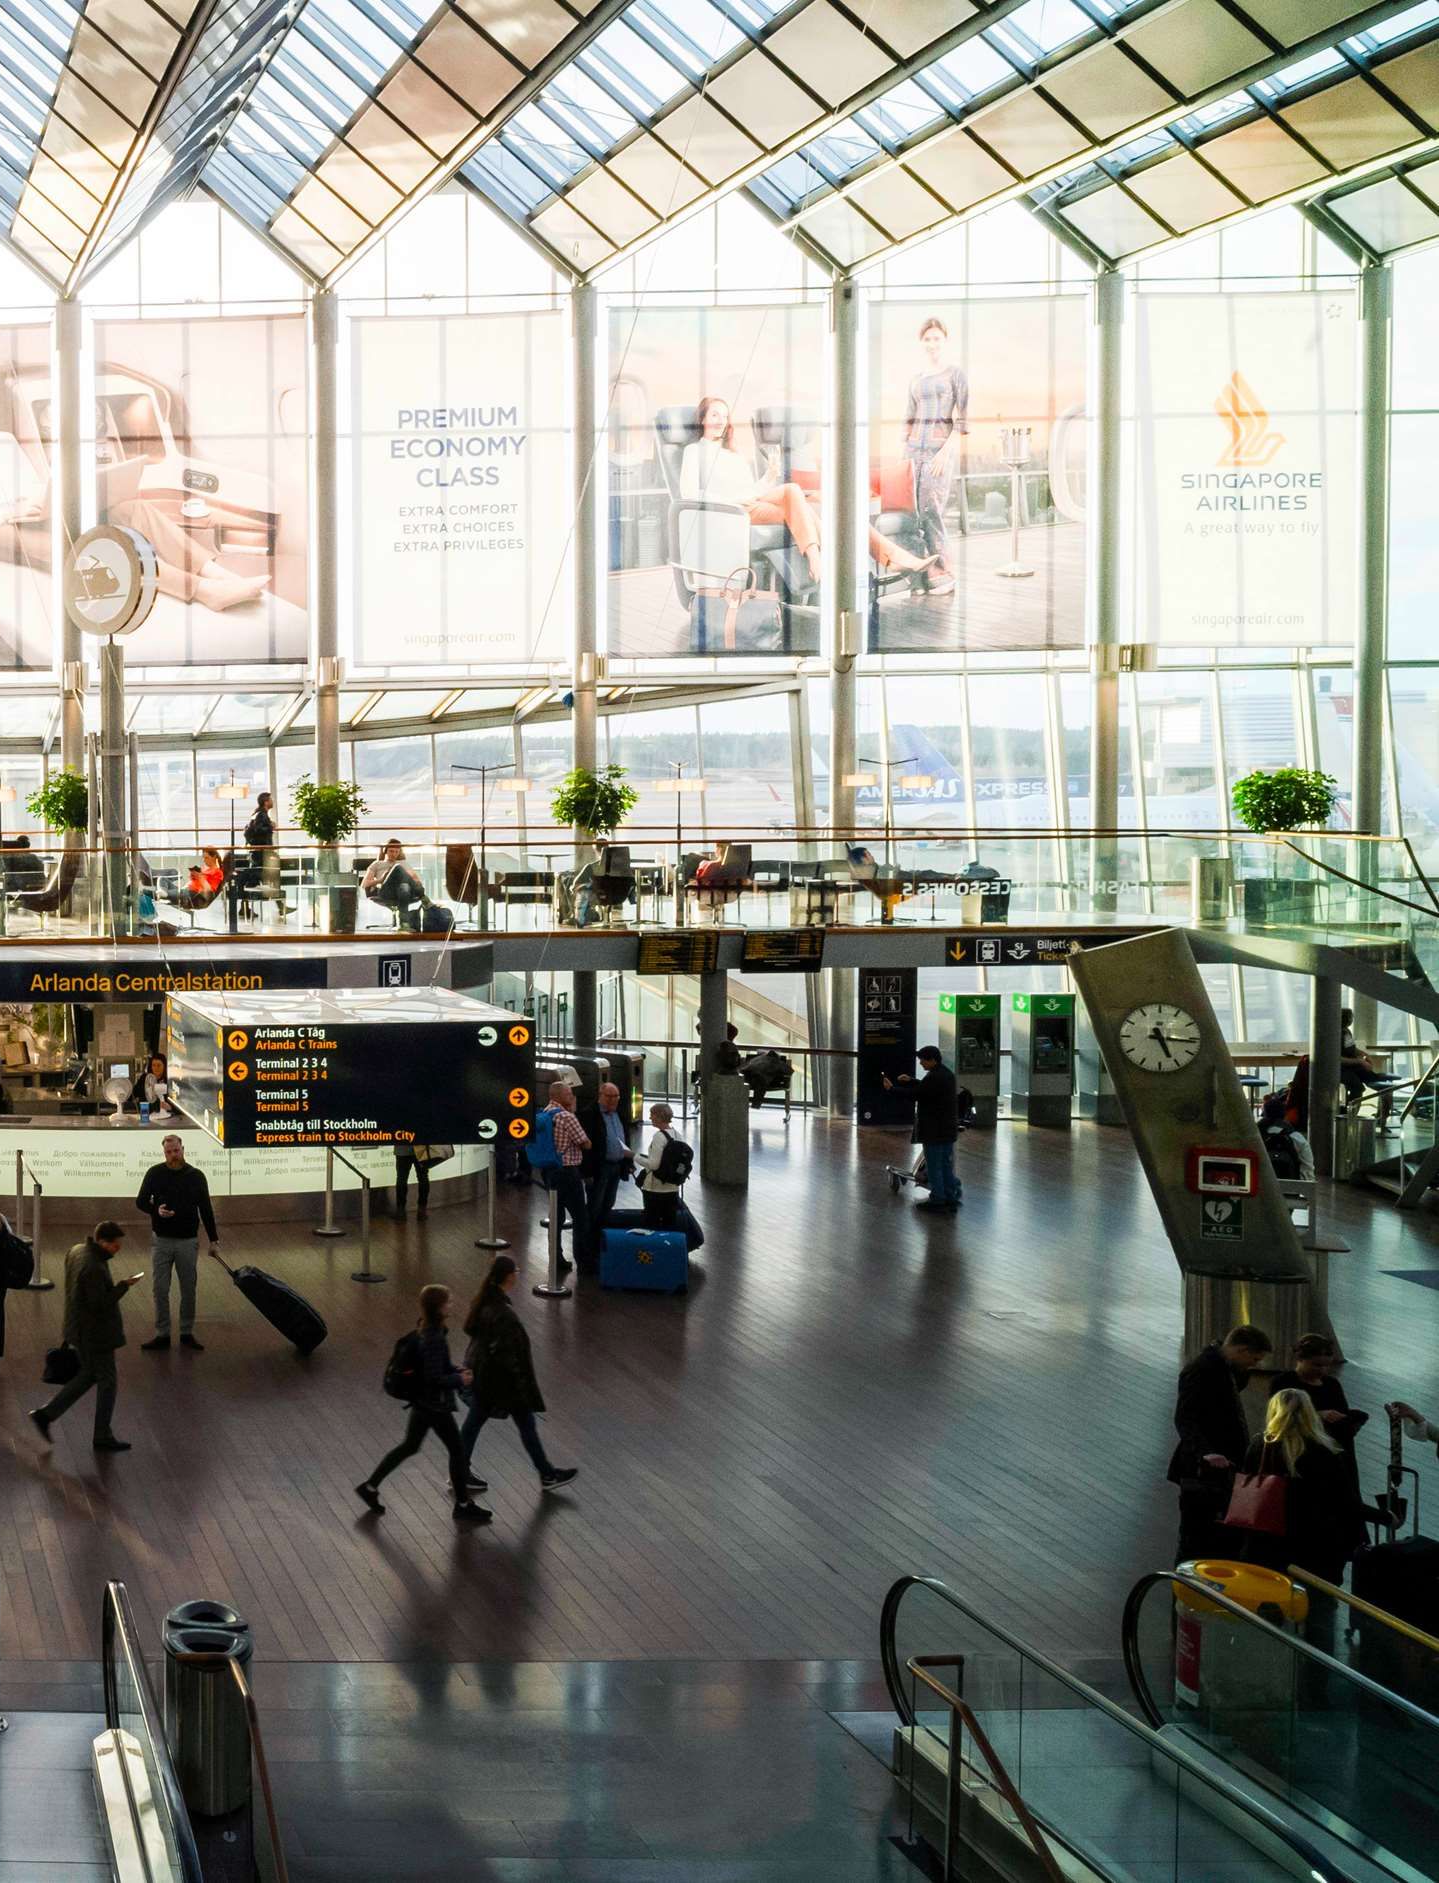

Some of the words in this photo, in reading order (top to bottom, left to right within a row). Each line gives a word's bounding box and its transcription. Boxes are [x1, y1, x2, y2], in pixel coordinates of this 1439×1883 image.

[398, 406, 517, 429] PREMIUM
[390, 435, 527, 459] ECONOMY
[416, 466, 500, 487] CLASS
[1180, 473, 1322, 489] SINGAPORE
[399, 506, 444, 517] EXTRA
[449, 504, 518, 516] COMFORT
[1196, 495, 1308, 511] AIRLINES
[403, 523, 448, 535] EXTRA
[453, 521, 514, 533] CHOICES
[1184, 522, 1194, 533] A
[1200, 522, 1239, 537] great
[1244, 522, 1275, 536] way
[1281, 522, 1295, 533] to
[1301, 521, 1319, 536] fly
[394, 542, 439, 552] EXTRA
[444, 539, 524, 551] PRIVILEGES
[975, 781, 1050, 796] XPRES
[30, 973, 110, 992] Arlanda
[115, 971, 263, 992] Centralstation
[255, 1027, 295, 1039] Arlanda
[297, 1027, 305, 1038] C
[307, 1026, 326, 1041] Tåg
[255, 1039, 296, 1050] Arlanda
[298, 1039, 306, 1050] C
[308, 1039, 337, 1050] Trains
[256, 1058, 300, 1069] Terminal
[302, 1058, 308, 1069] 2
[311, 1058, 318, 1069] 3
[321, 1058, 328, 1069] 4
[256, 1070, 300, 1081] Terminal
[302, 1070, 308, 1081] 2
[311, 1070, 318, 1081] 3
[321, 1070, 328, 1081] 4
[256, 1089, 300, 1100] Terminal
[302, 1089, 309, 1100] 5
[256, 1101, 300, 1112] Terminal
[302, 1101, 309, 1112] 5
[255, 1119, 304, 1134] Snabbtåg
[307, 1118, 321, 1130] till
[323, 1118, 377, 1130] Stockholm
[256, 1131, 295, 1144] Express
[297, 1131, 322, 1142] train
[324, 1132, 336, 1142] to
[338, 1130, 392, 1142] Stockholm
[394, 1129, 416, 1143] City
